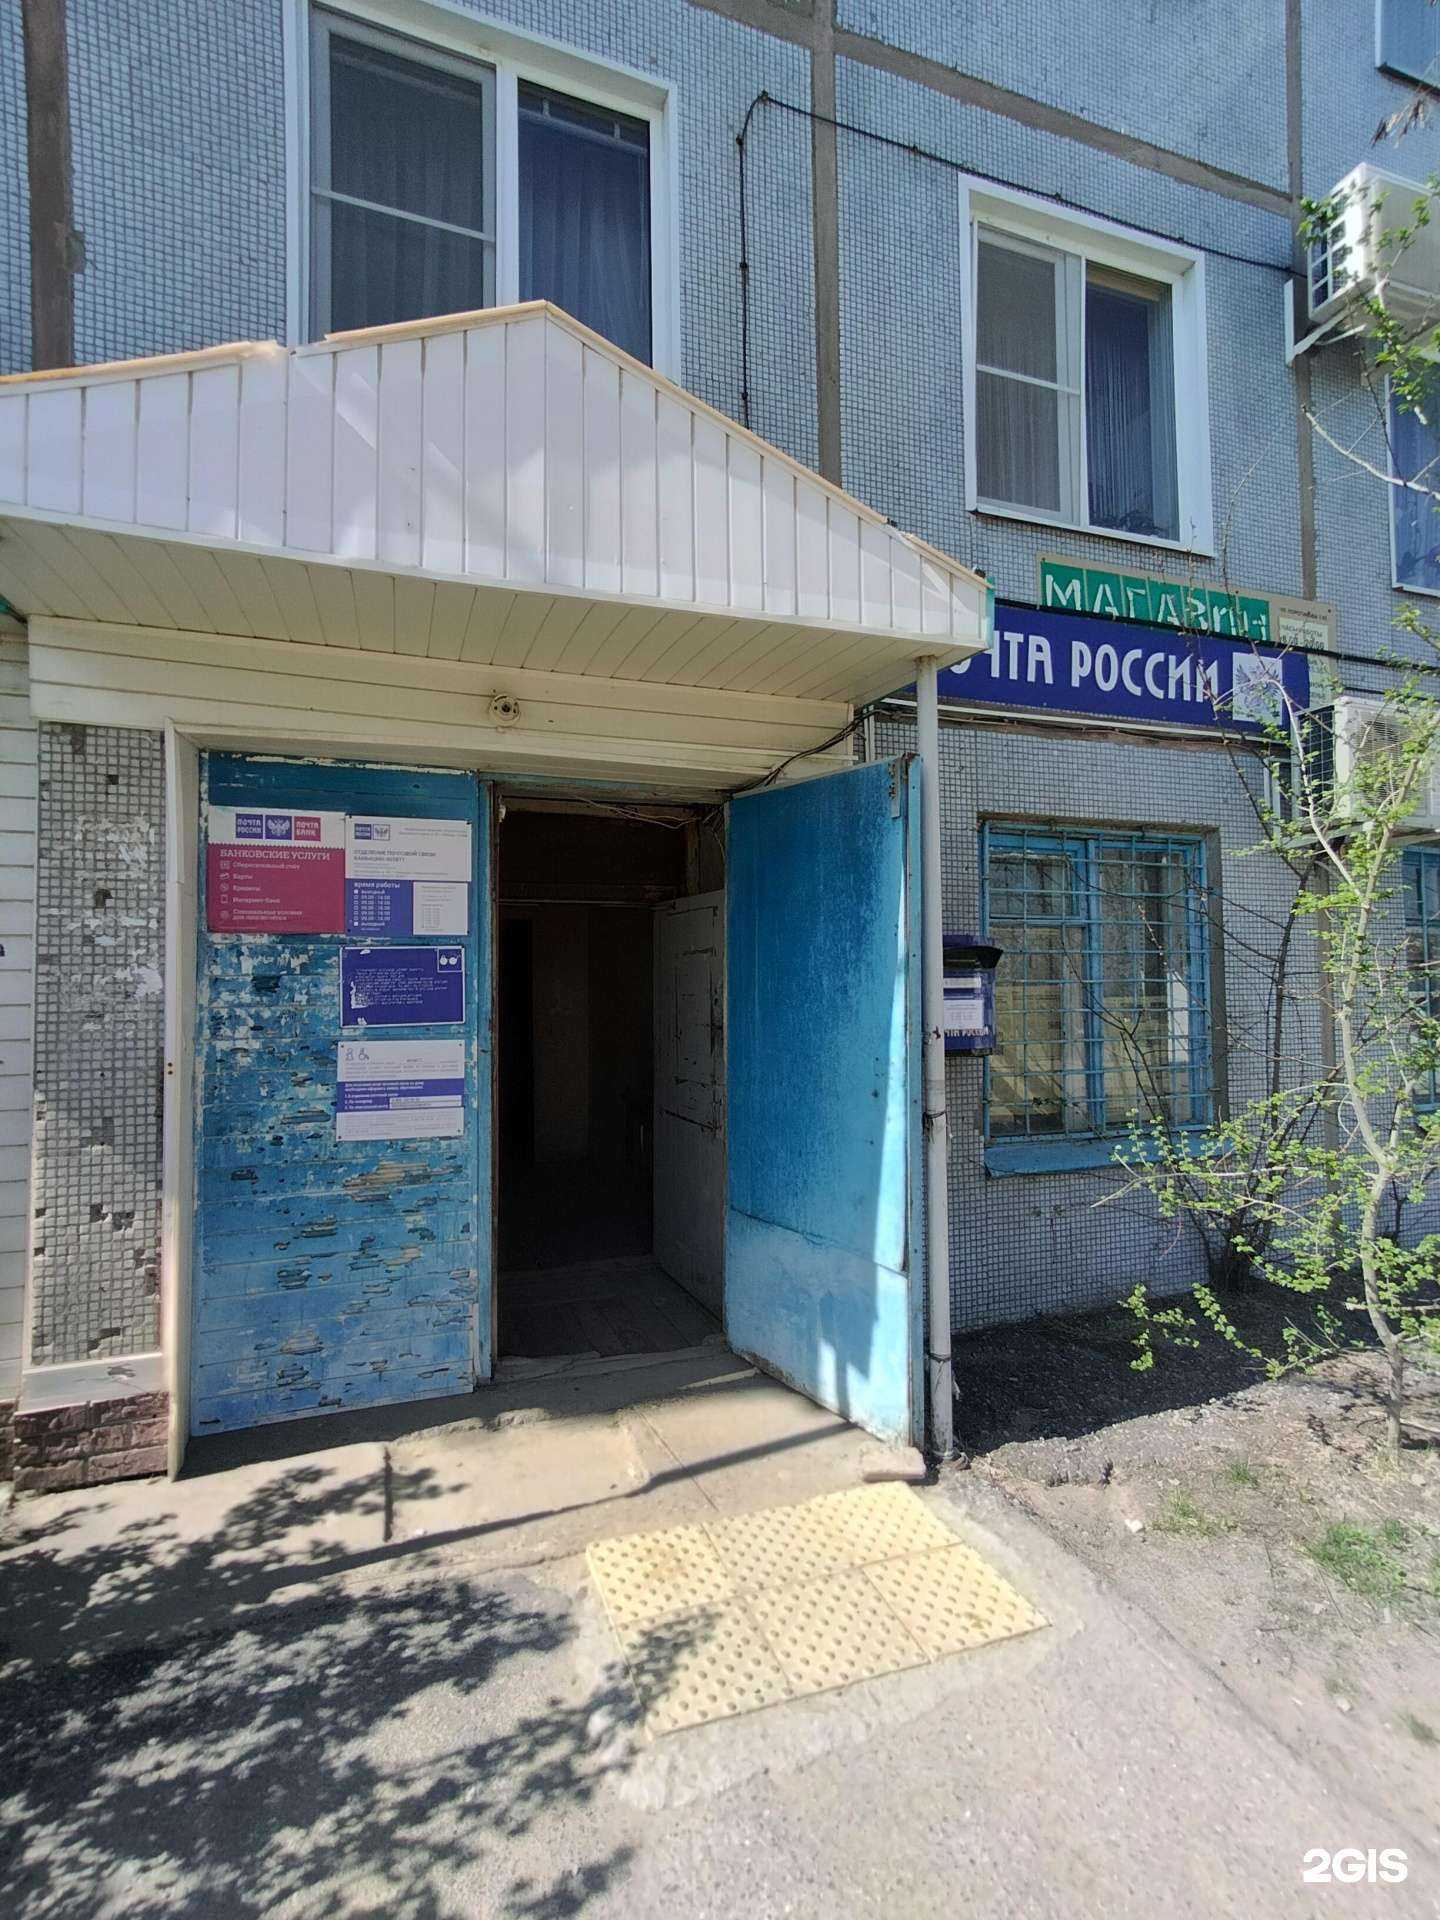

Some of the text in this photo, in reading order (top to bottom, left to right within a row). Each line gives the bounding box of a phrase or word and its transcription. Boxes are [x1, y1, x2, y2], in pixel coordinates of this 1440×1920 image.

[949, 630, 1219, 703] ЧТА РОССИИ
[220, 848, 330, 861] БАНКОВСКИЕ УСЛУГИ
